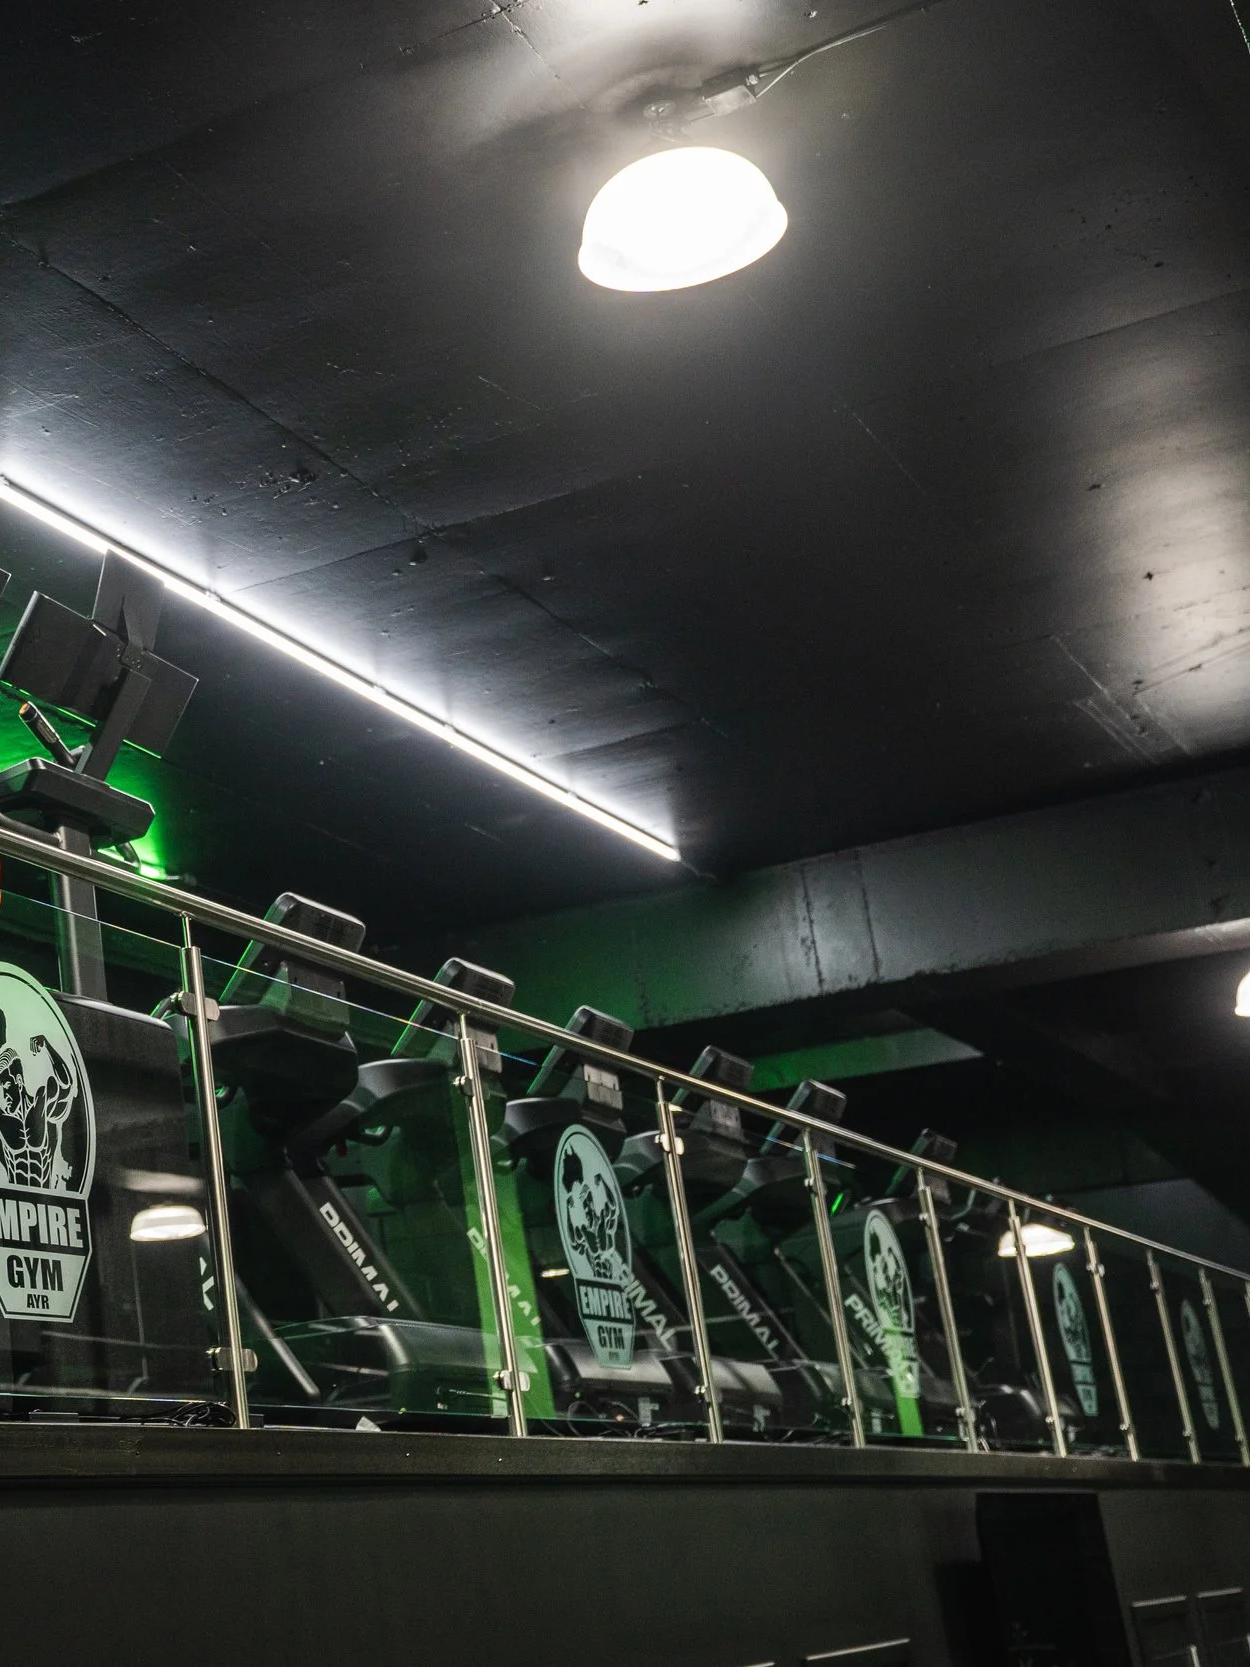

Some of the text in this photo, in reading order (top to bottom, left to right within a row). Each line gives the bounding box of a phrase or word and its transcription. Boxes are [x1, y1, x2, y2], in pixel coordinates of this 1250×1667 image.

[6, 1254, 64, 1292] GYM
[26, 1293, 50, 1310] AYR
[579, 1285, 632, 1320] EMPIRE
[601, 1247, 676, 1351] PRIMAL
[597, 1325, 625, 1350] GYM
